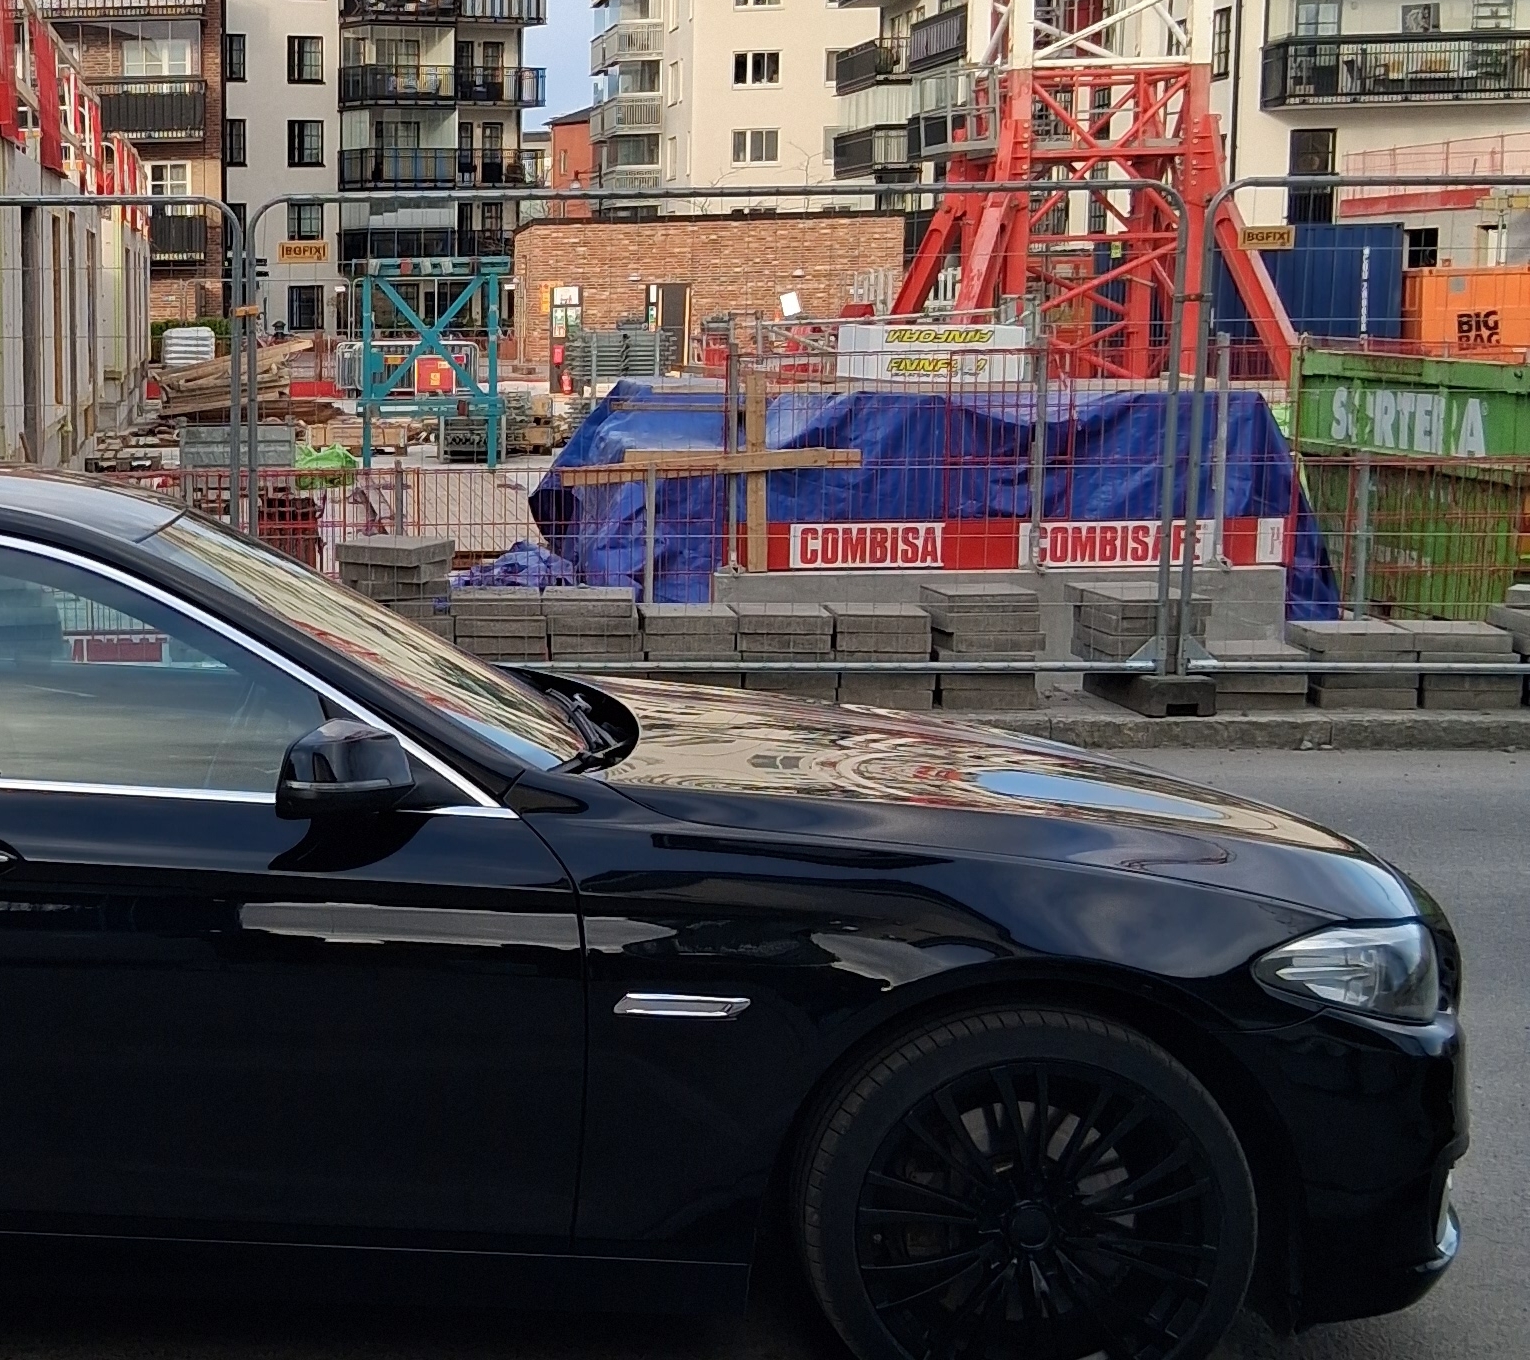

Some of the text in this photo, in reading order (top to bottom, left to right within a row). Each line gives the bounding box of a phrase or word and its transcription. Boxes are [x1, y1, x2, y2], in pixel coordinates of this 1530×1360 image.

[1246, 231, 1286, 242] BGFIX
[285, 245, 322, 256] BGFIX
[1457, 310, 1499, 334] BIG
[1457, 331, 1501, 351] BAG
[800, 526, 942, 564] COMBISA
